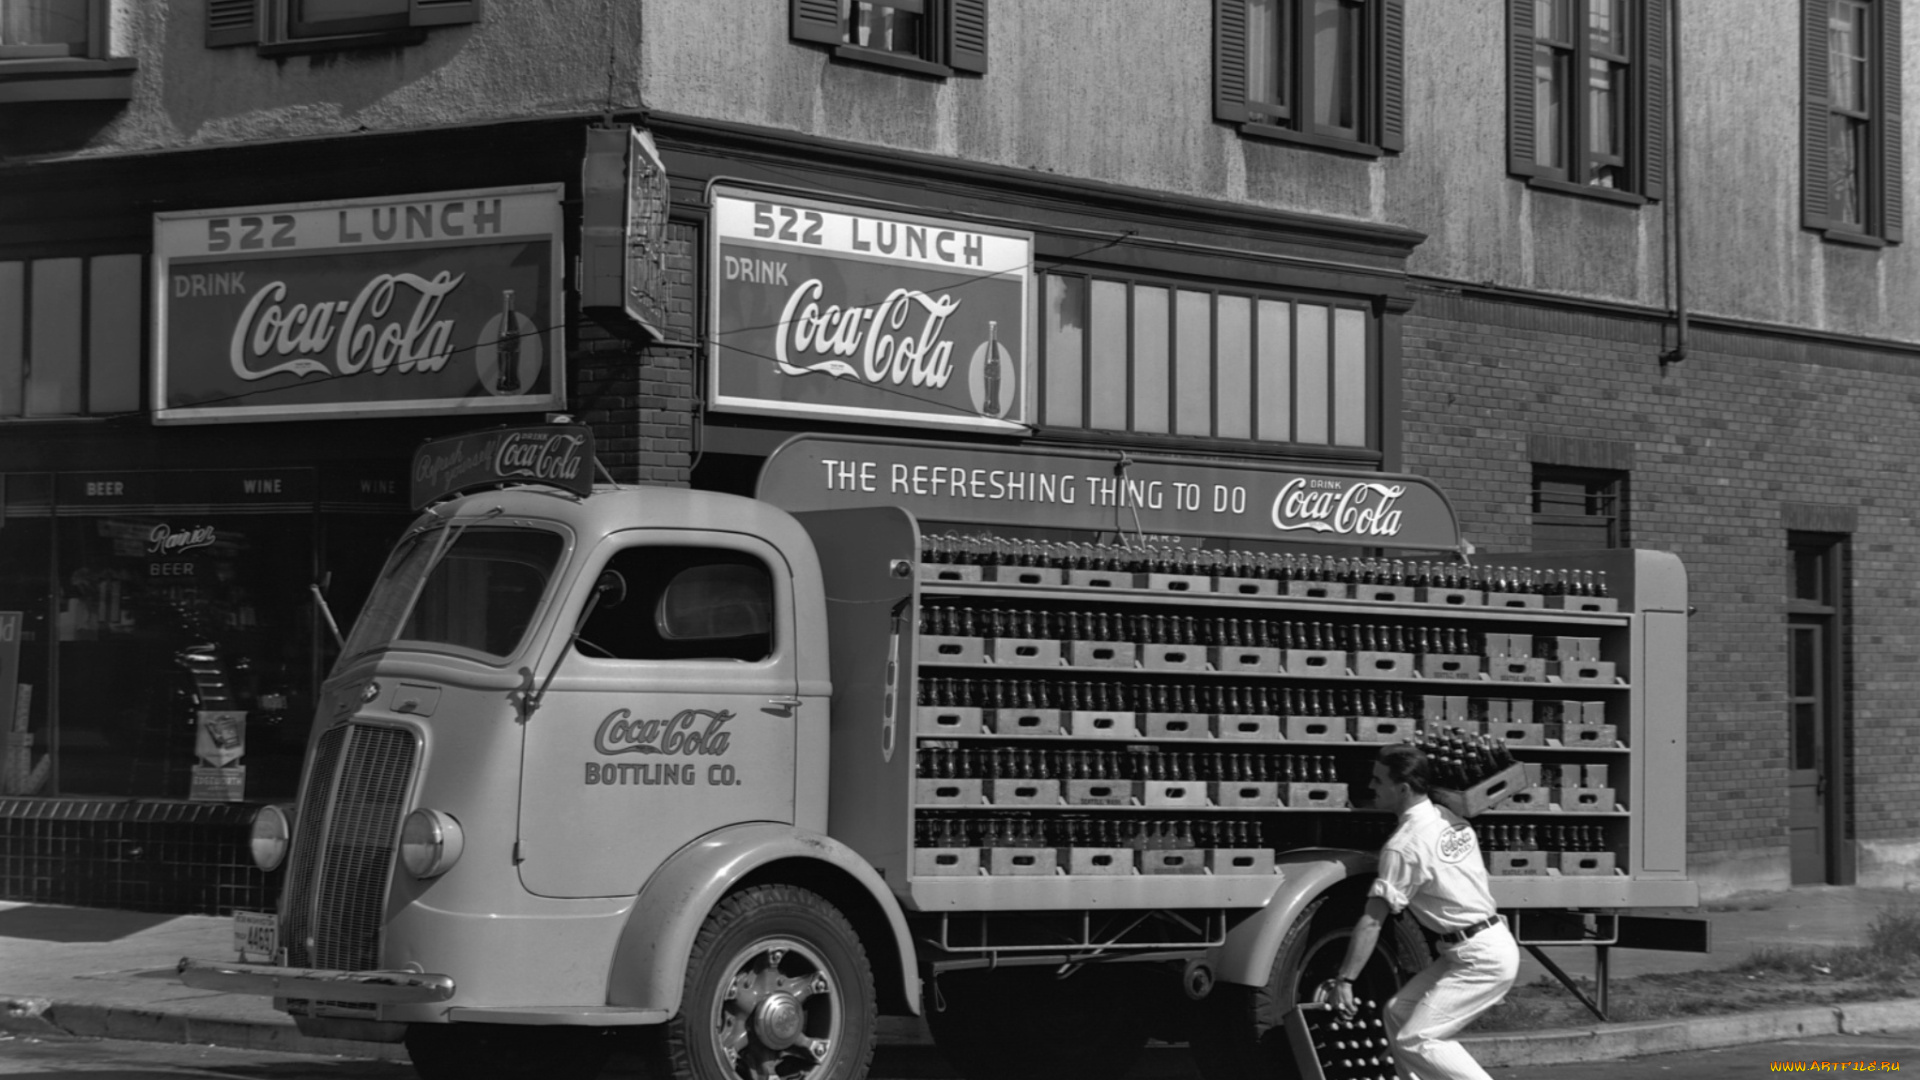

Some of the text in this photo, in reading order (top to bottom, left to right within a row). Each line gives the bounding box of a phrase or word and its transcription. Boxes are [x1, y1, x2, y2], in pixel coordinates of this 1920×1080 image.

[208, 199, 502, 252] 522 LUNCH
[753, 204, 983, 267] 522 LUNCH
[175, 271, 246, 298] DRINK
[725, 255, 788, 287] DRINK
[230, 270, 465, 381] Coca-Cola
[775, 278, 961, 389] Coca-Cola
[521, 432, 549, 440] DRINK
[496, 432, 586, 479] Coca-Cola
[86, 481, 124, 497] BEER
[243, 478, 282, 494] WINE
[360, 479, 395, 494] WINE
[822, 460, 1246, 514] THE REFRESHING THING TO DO
[1310, 478, 1342, 490] DRINK
[1272, 478, 1405, 536] Coca-Cola
[147, 523, 216, 556] Rainier
[149, 562, 195, 576] BEER
[594, 708, 737, 756] Coca-Cola
[585, 762, 742, 787] BOTTLING CO.
